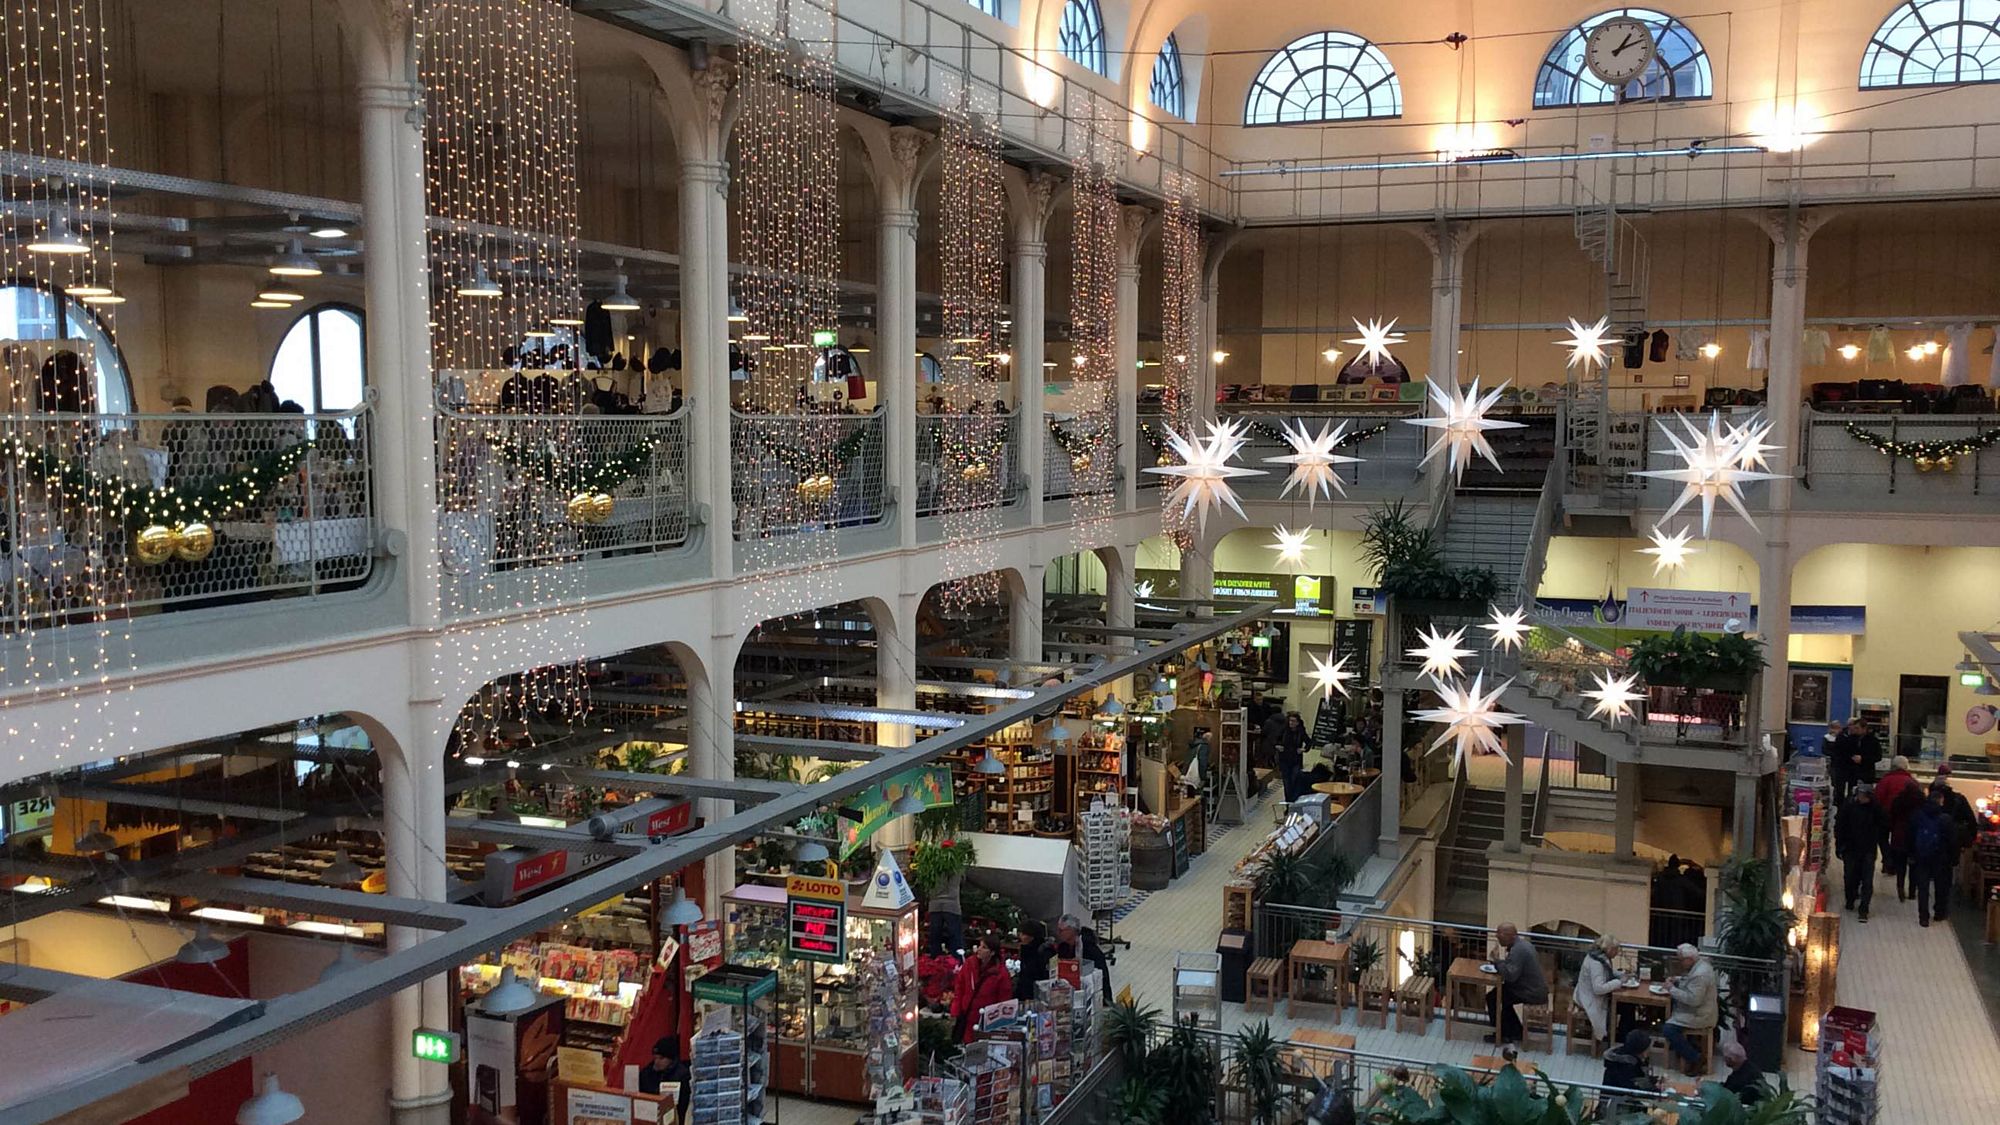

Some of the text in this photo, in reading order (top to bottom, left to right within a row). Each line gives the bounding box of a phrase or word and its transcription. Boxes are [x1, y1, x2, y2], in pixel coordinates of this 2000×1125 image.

[651, 817, 672, 831] West
[519, 864, 543, 882] West
[806, 881, 841, 896] LOTTO
